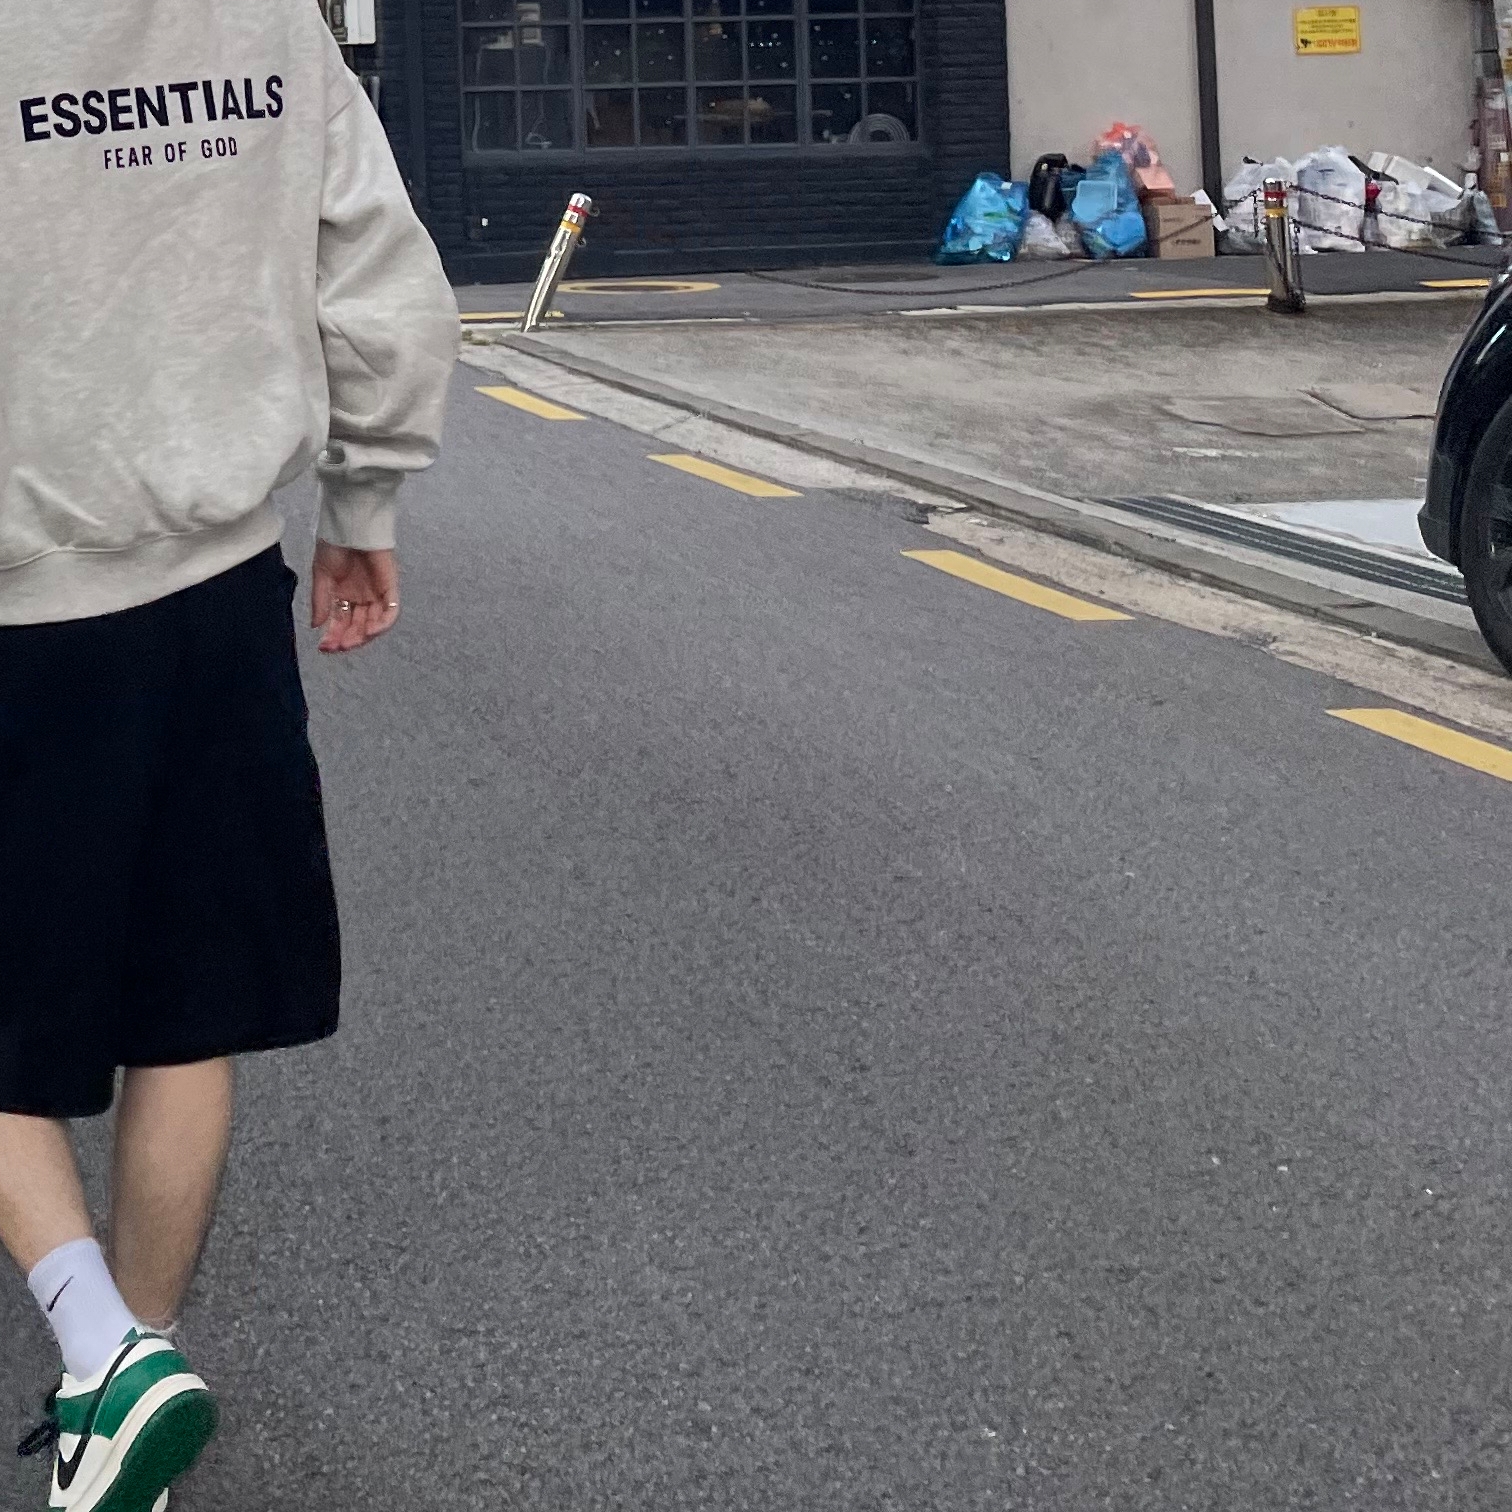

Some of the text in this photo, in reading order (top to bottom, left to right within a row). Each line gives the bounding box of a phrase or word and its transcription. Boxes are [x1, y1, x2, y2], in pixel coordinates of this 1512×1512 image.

[19, 74, 284, 143] ESSENTIALS
[103, 136, 239, 170] FEAR OF GOD
